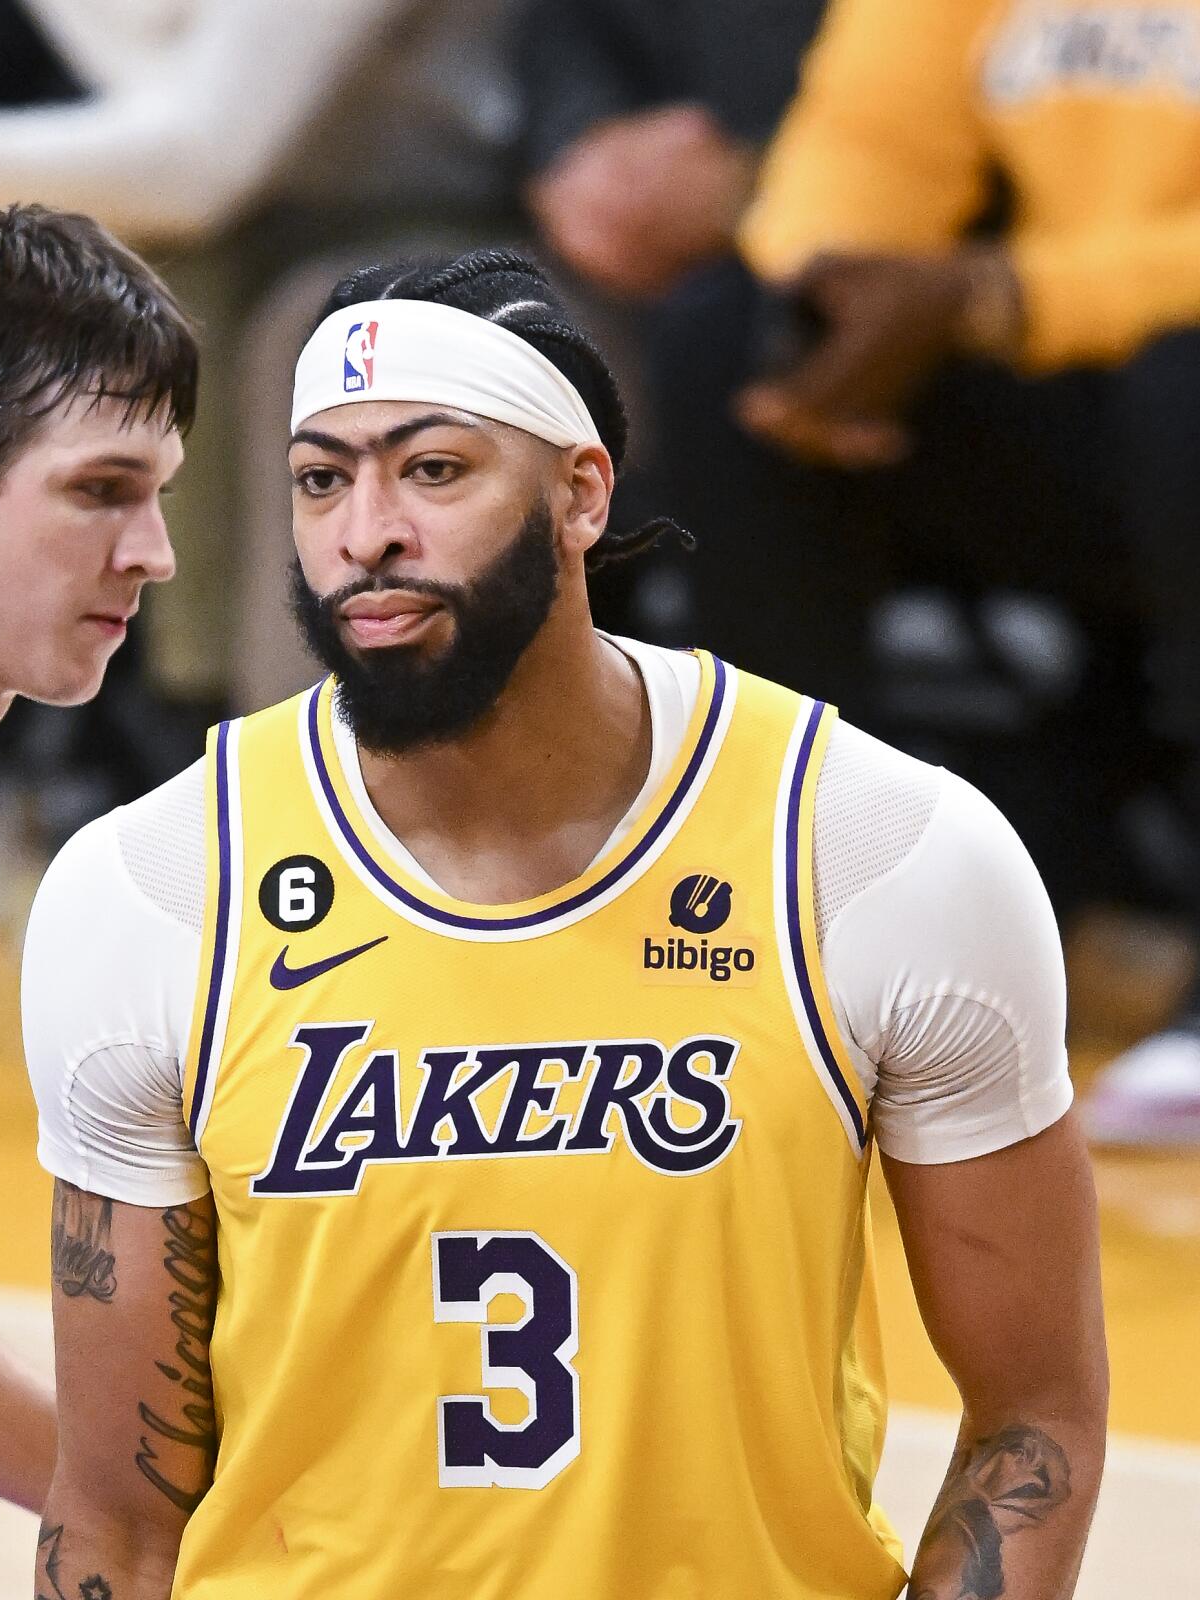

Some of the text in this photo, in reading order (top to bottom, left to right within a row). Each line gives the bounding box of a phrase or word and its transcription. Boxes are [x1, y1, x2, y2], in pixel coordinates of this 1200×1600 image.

[276, 866, 315, 922] 6
[643, 938, 755, 982] bibigo
[249, 1019, 743, 1198] LAKERS
[430, 1229, 581, 1491] 3
